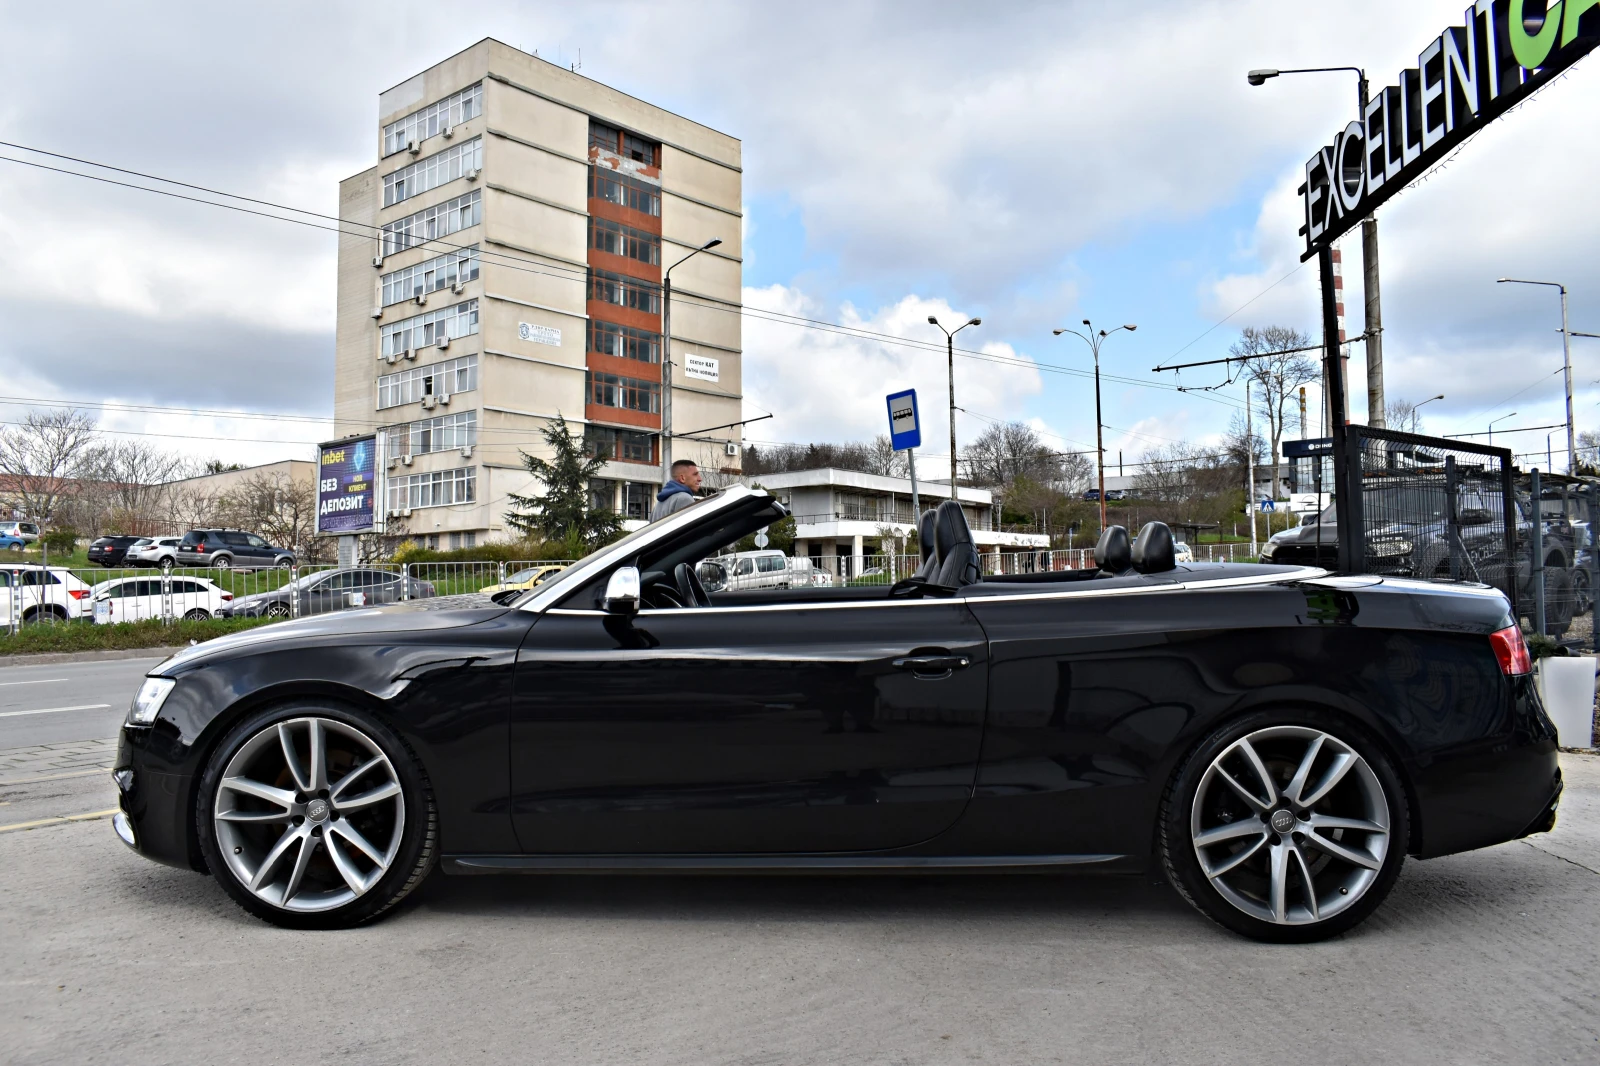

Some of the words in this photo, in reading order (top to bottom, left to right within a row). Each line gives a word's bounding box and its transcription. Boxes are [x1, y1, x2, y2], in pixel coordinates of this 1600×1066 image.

[1306, 0, 1498, 242] EXCELLENT
[322, 449, 345, 465] inbet
[321, 478, 338, 492] БЕЗ
[348, 483, 367, 492] КЛИЕНТ
[320, 495, 364, 515] ДЕПОЗИТ
